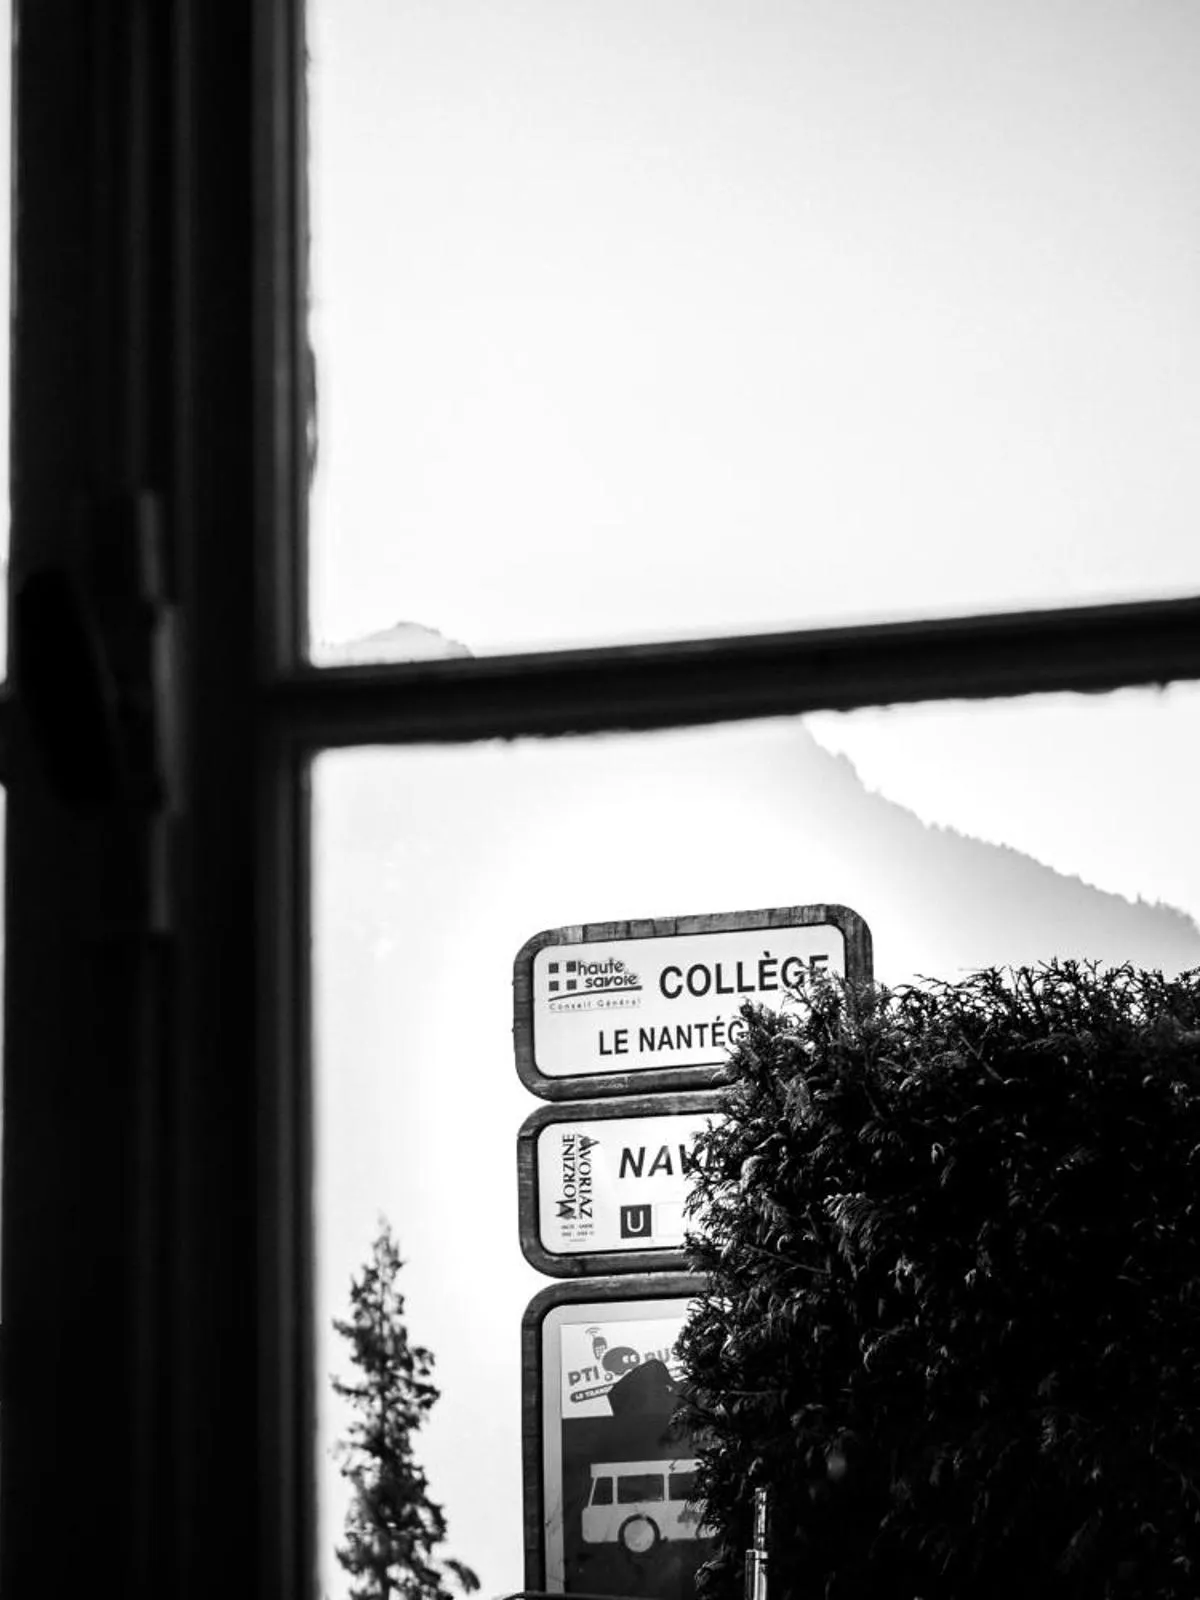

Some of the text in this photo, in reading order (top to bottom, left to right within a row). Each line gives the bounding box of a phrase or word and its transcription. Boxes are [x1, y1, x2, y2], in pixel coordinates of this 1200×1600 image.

[578, 958, 624, 975] haute
[584, 975, 638, 988] savoie
[599, 1029, 628, 1055] LE
[555, 1134, 577, 1219] MORZINE
[578, 1134, 600, 1219] AVORIAZ
[627, 1211, 644, 1232] U
